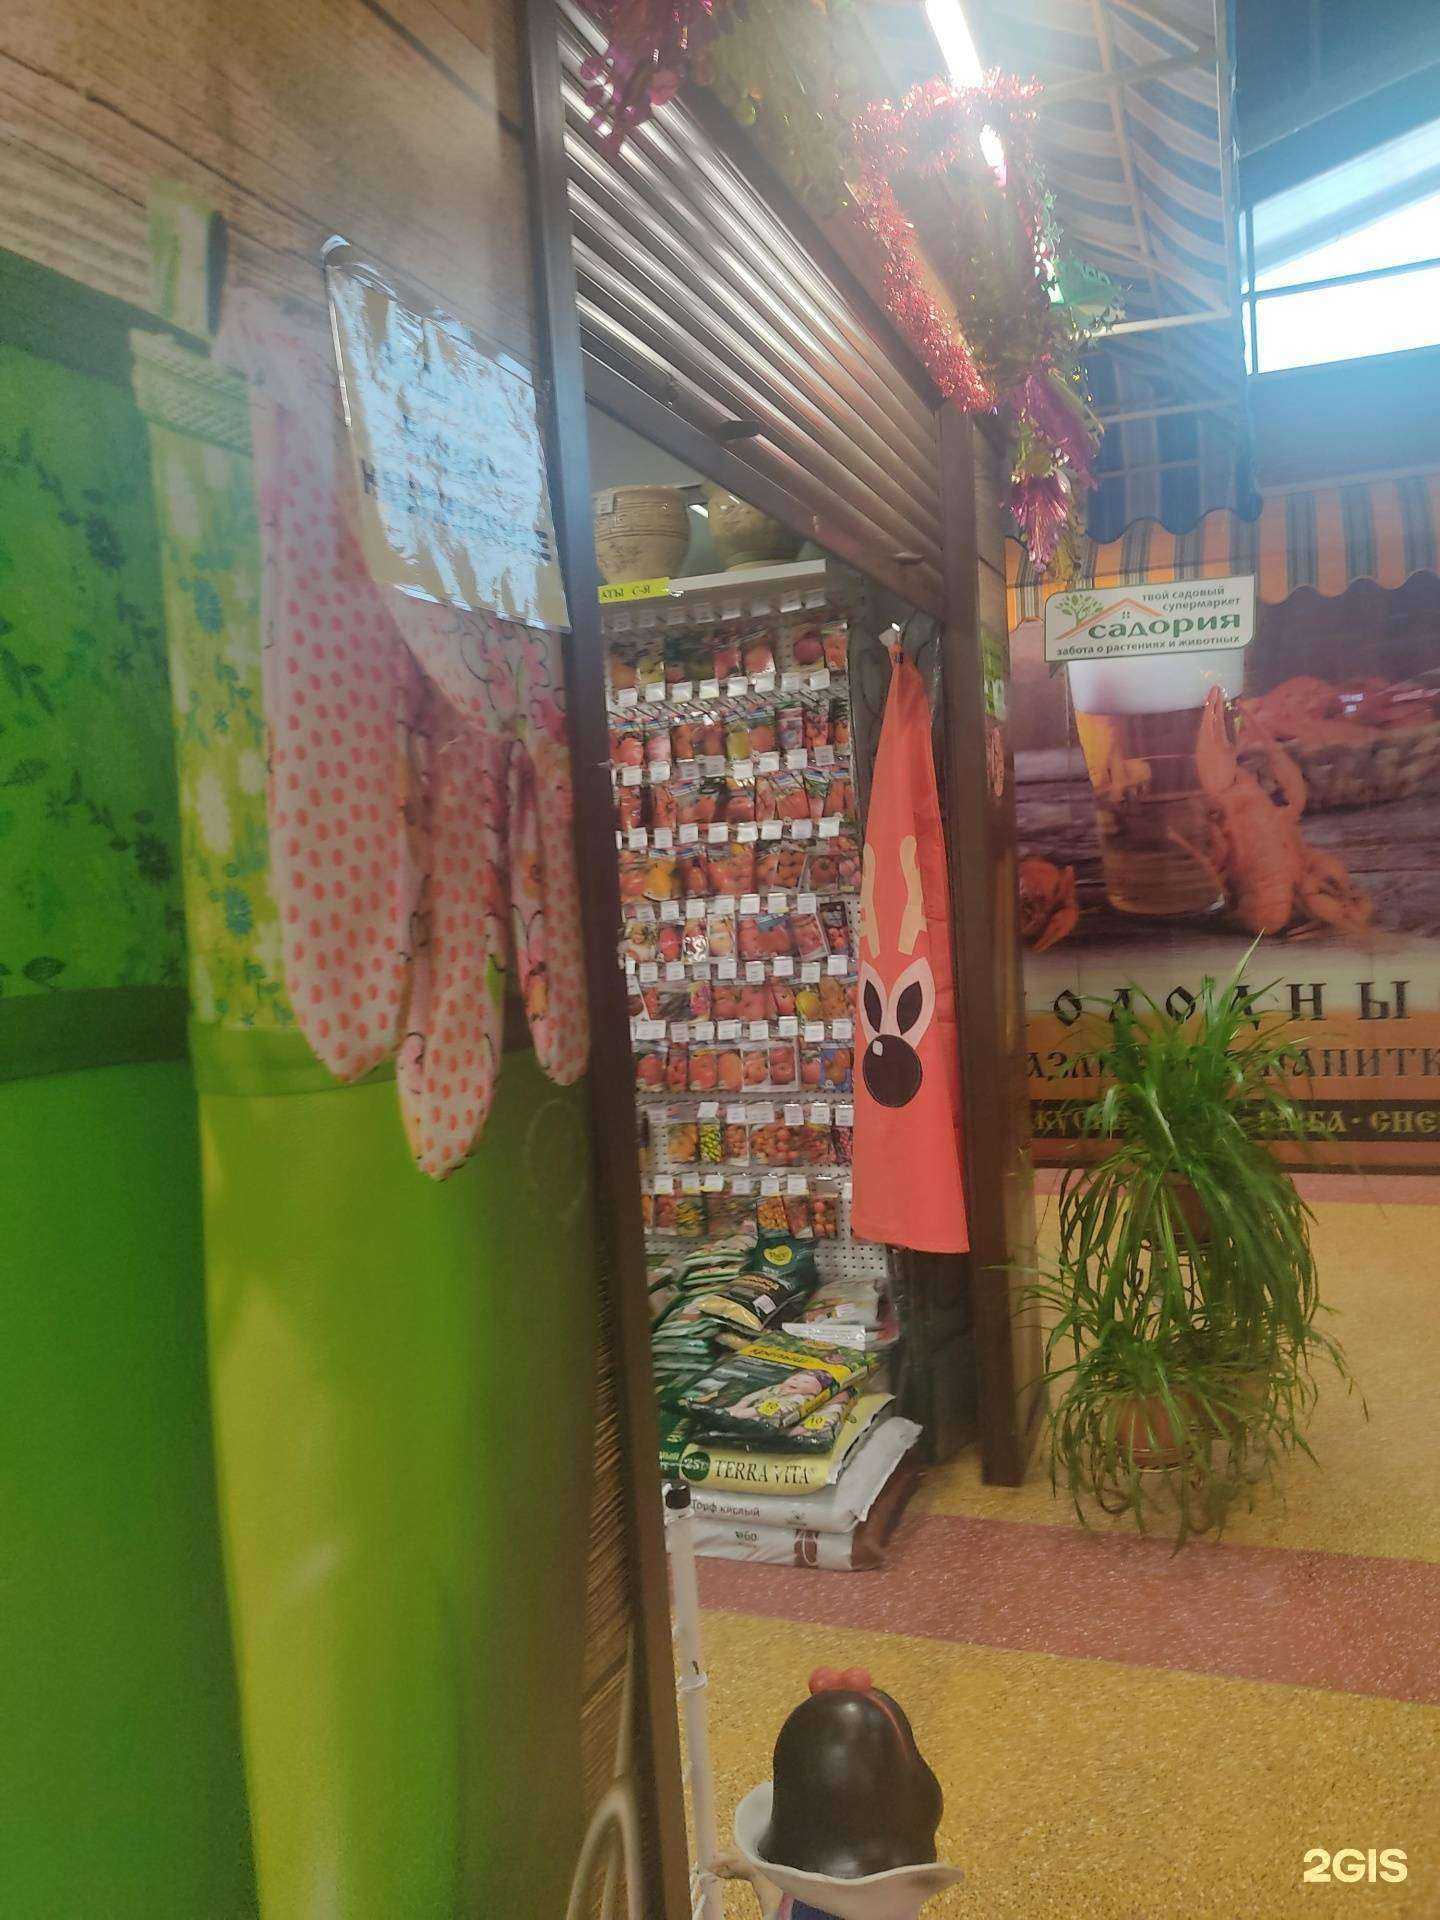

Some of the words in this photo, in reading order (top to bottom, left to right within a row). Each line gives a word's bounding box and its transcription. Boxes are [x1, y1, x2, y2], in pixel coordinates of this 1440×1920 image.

[1142, 588, 1170, 602] твой
[1172, 583, 1226, 600] садовый
[1162, 597, 1240, 613] супермаркет
[1088, 613, 1240, 640] садория
[1056, 644, 1094, 657] забота
[1106, 640, 1166, 656] растениях
[1168, 639, 1176, 649] и
[1178, 634, 1241, 649] животных
[1371, 1110, 1440, 1133] СНЕ
[715, 1459, 768, 1482] TERRA
[774, 1464, 810, 1485] VITA
